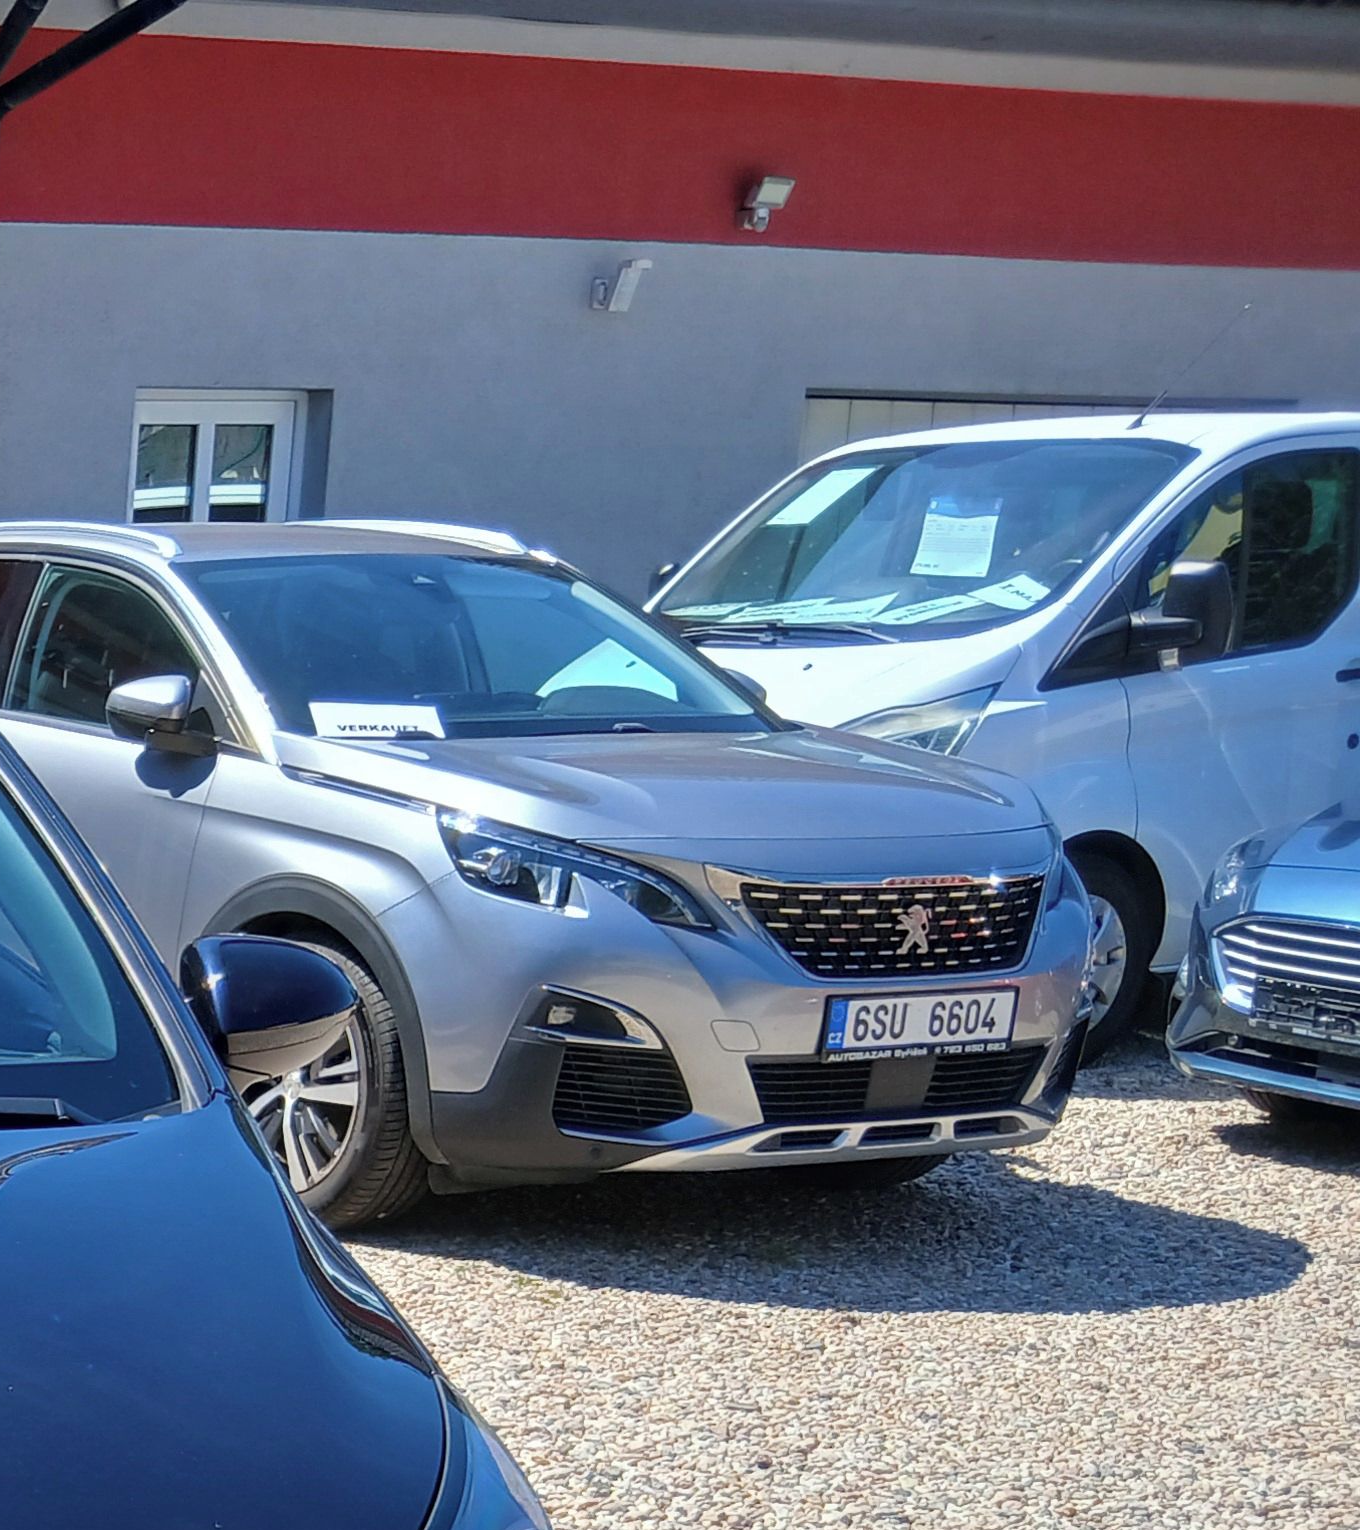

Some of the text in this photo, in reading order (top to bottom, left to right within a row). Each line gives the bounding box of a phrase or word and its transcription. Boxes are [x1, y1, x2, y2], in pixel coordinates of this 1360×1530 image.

[853, 998, 997, 1042] 6SU 6604
[828, 1032, 842, 1044] CZ
[828, 1050, 892, 1062] AUTOBAZAR
